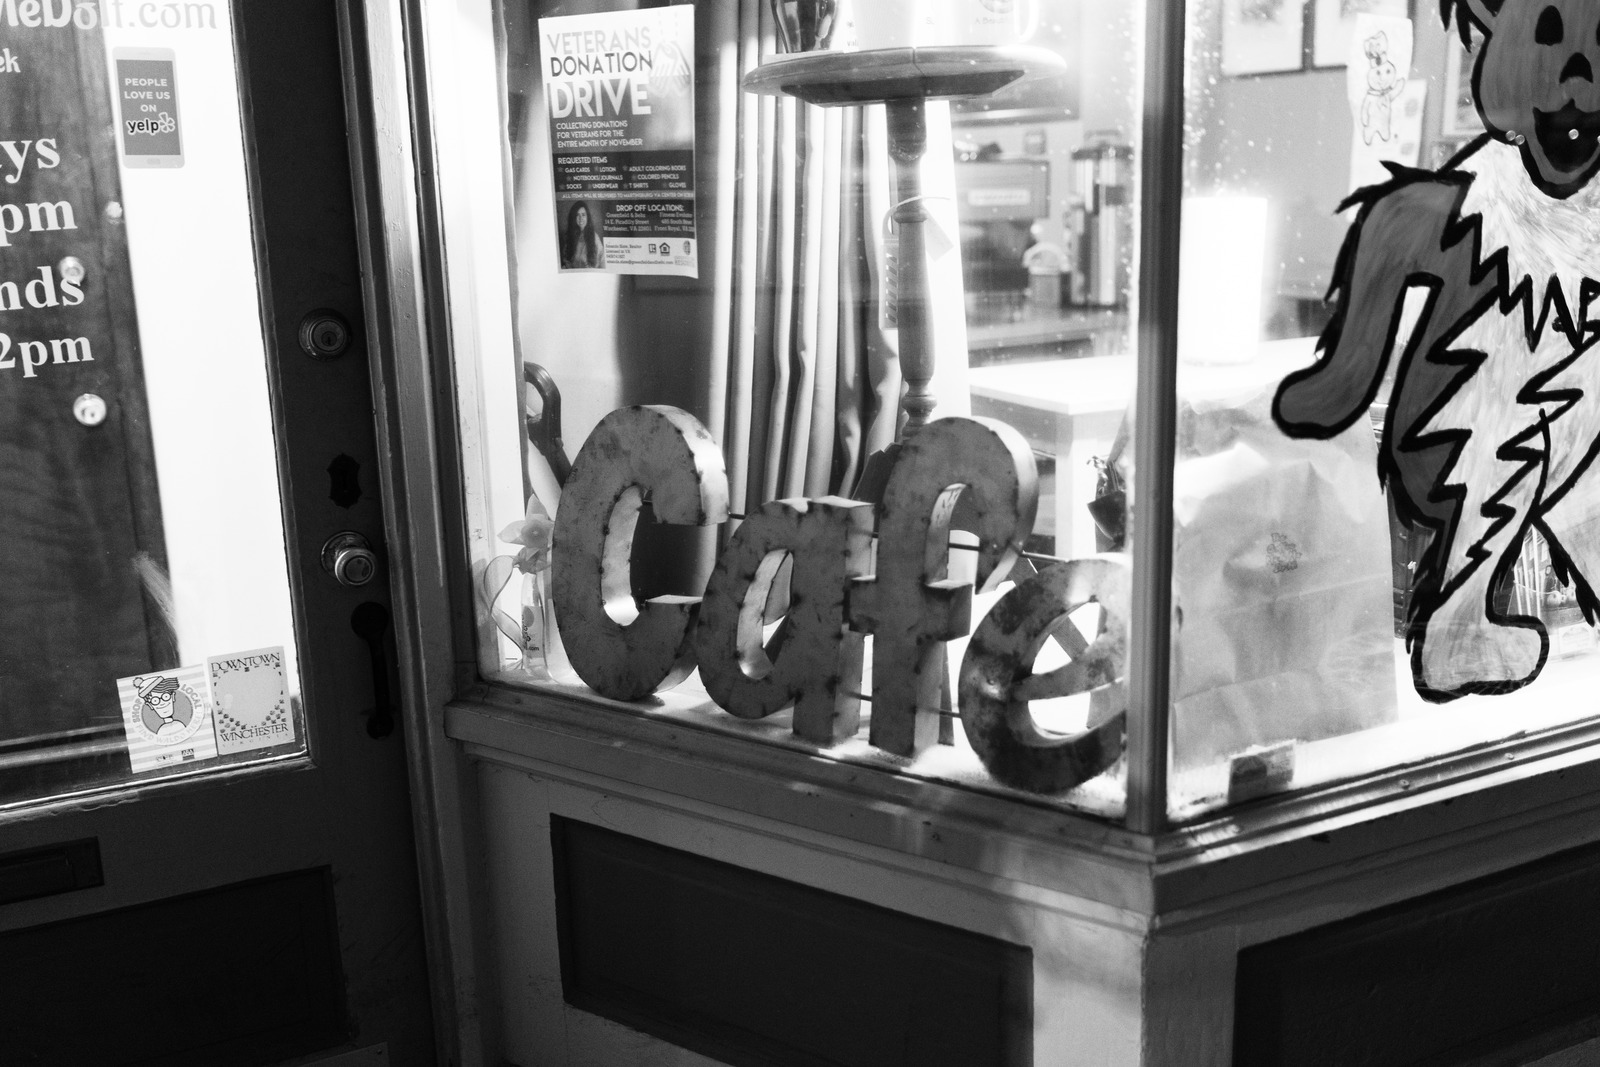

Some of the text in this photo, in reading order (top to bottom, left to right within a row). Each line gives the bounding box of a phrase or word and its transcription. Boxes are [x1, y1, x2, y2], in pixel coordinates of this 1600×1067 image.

[547, 26, 652, 55] VETERANS
[550, 50, 652, 77] DONATION
[125, 78, 168, 87] PEOPLE
[124, 91, 171, 99] LOVE US
[550, 78, 652, 119] DRIVE
[140, 104, 157, 112] ON
[127, 118, 160, 134] yelp
[556, 120, 628, 130] COLLECTING DONATIONS
[556, 131, 570, 139] FOR
[570, 130, 599, 138] VETERANS
[613, 129, 624, 137] THE
[558, 138, 643, 148] ENTIRE MONTH OF NOVEMBER
[0, 138, 60, 184] ys
[558, 156, 608, 164] REQUESTED ITEMS
[616, 204, 684, 212] DROP OFF LOCATIONS:
[552, 405, 1128, 794] Cafe
[211, 652, 280, 672] DOWNTOWN
[181, 684, 202, 709] LOCAL
[132, 698, 142, 723] SHOP
[136, 724, 154, 741] FIND
[220, 722, 289, 742] WINCHESTER
